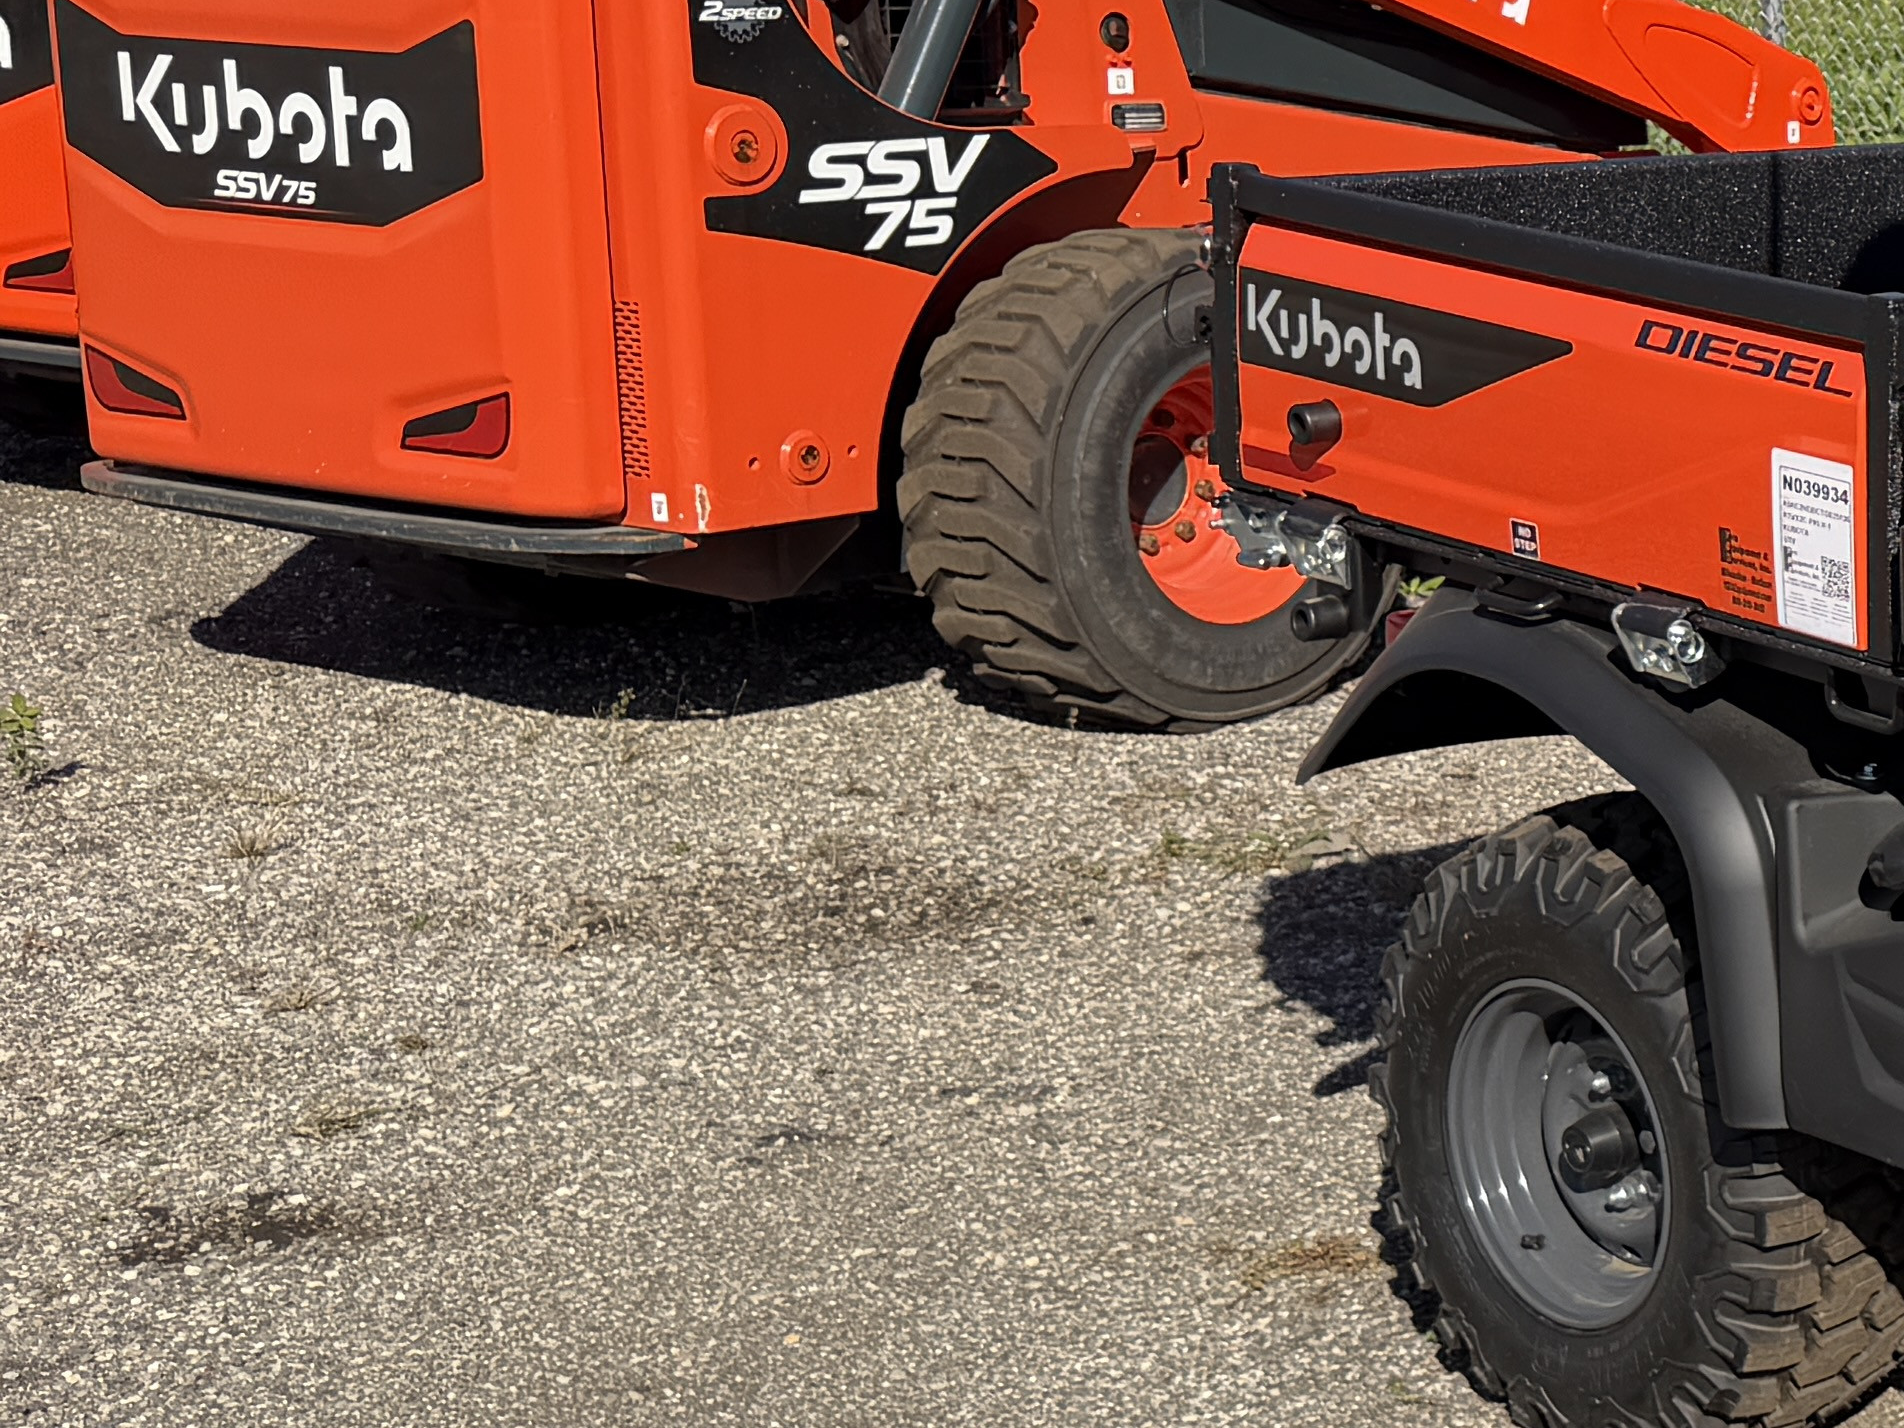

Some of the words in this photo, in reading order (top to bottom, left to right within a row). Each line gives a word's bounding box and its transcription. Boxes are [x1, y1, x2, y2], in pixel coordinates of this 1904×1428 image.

[117, 51, 412, 172] Kubota
[799, 134, 990, 203] SSV
[863, 197, 957, 250] 75
[1248, 284, 1422, 390] Kubota
[1635, 319, 1852, 398] DIESEL
[1783, 474, 1849, 505] N039934
